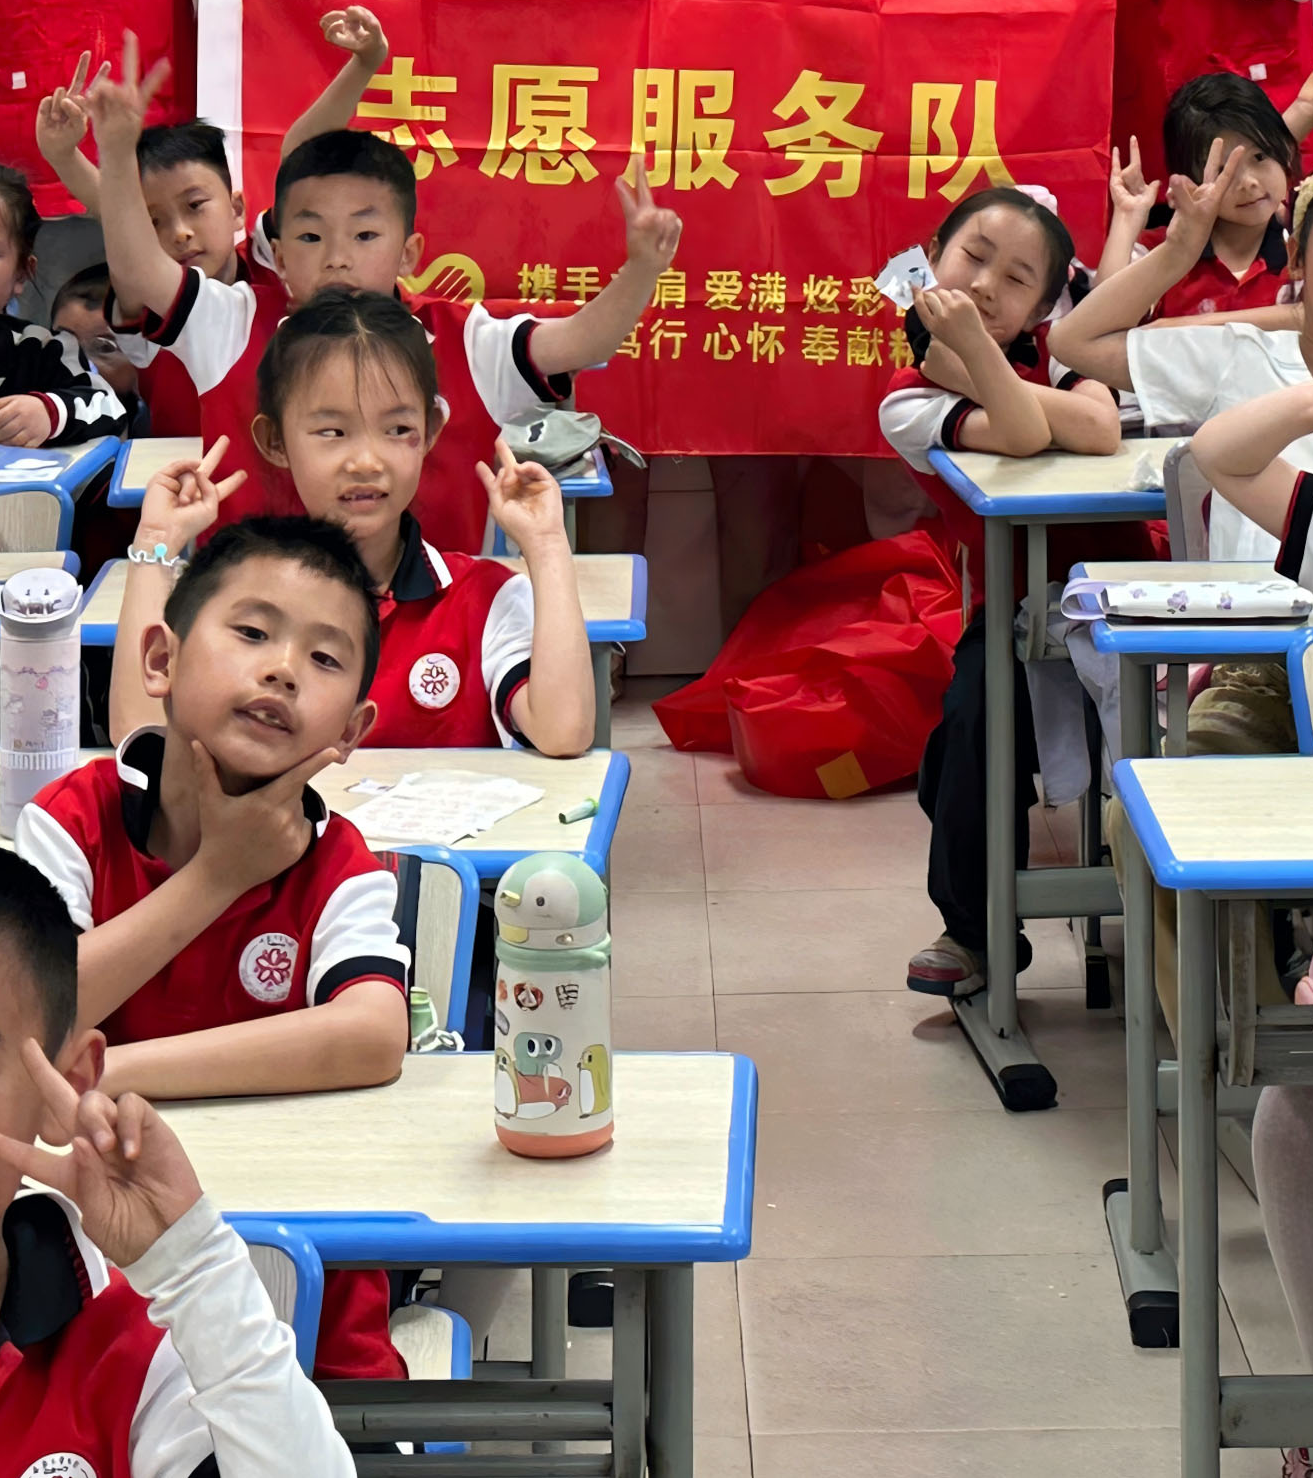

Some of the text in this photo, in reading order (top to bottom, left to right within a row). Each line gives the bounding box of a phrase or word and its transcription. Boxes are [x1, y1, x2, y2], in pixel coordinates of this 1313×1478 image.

[355, 55, 1018, 203] 志愿服务队
